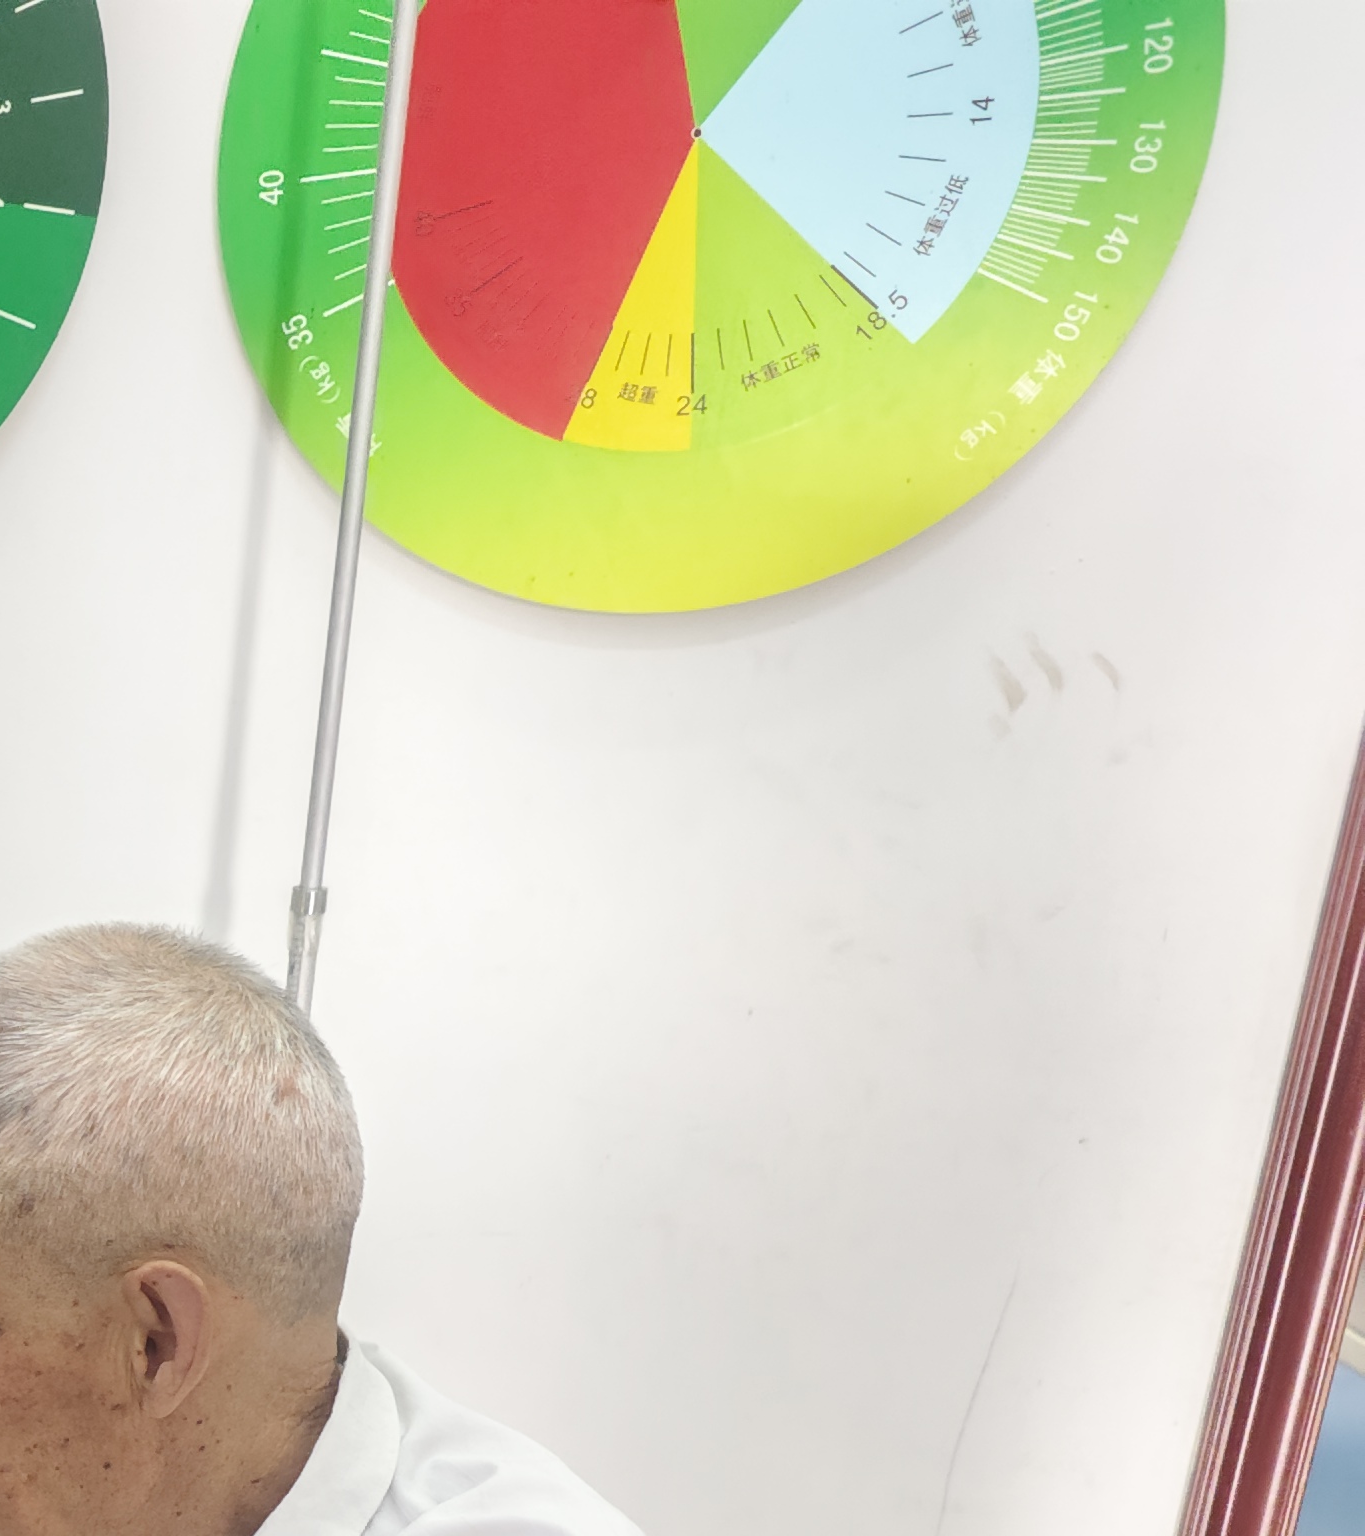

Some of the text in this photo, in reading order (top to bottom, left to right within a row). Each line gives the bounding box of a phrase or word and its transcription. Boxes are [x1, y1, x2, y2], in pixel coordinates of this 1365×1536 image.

[1143, 17, 1174, 74] 120
[969, 96, 995, 125] 14
[1130, 120, 1166, 173] 130
[259, 169, 285, 206] 40
[913, 174, 970, 256] 体重过低
[1095, 213, 1140, 264] 140
[281, 313, 314, 350] 35
[855, 289, 909, 340] 18.5
[1053, 290, 1099, 341] 150
[741, 341, 822, 392] 体重正常
[616, 381, 660, 405] 超重
[676, 393, 709, 417] 24
